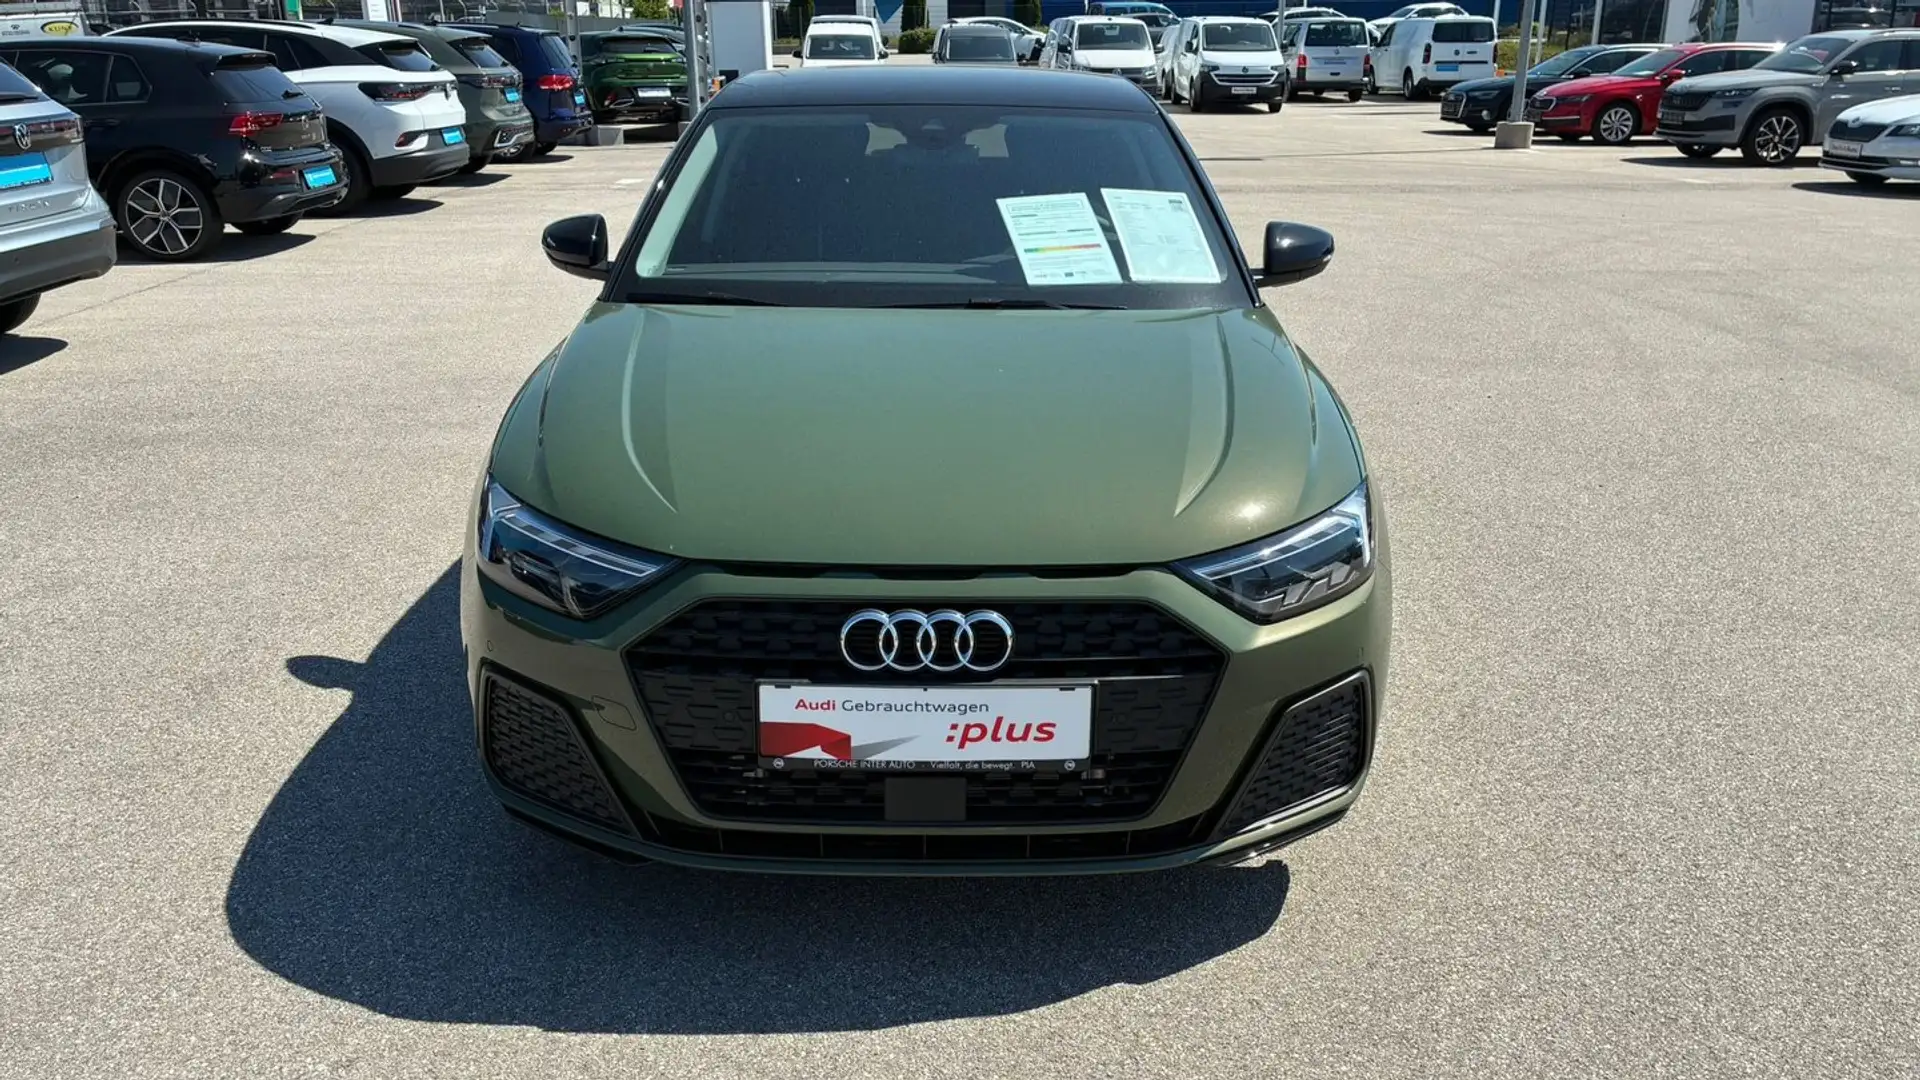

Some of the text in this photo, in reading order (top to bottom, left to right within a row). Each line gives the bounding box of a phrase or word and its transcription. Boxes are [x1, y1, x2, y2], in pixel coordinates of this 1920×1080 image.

[795, 699, 989, 716] Audi Gebrauchtwagen
[946, 716, 1057, 750] :plus
[813, 760, 857, 768] PORSCHE
[861, 760, 886, 769] INTER
[888, 760, 916, 769] AUTO
[930, 760, 963, 770] Vielfalt,
[965, 760, 979, 769] die
[1021, 761, 1035, 769] PIA
